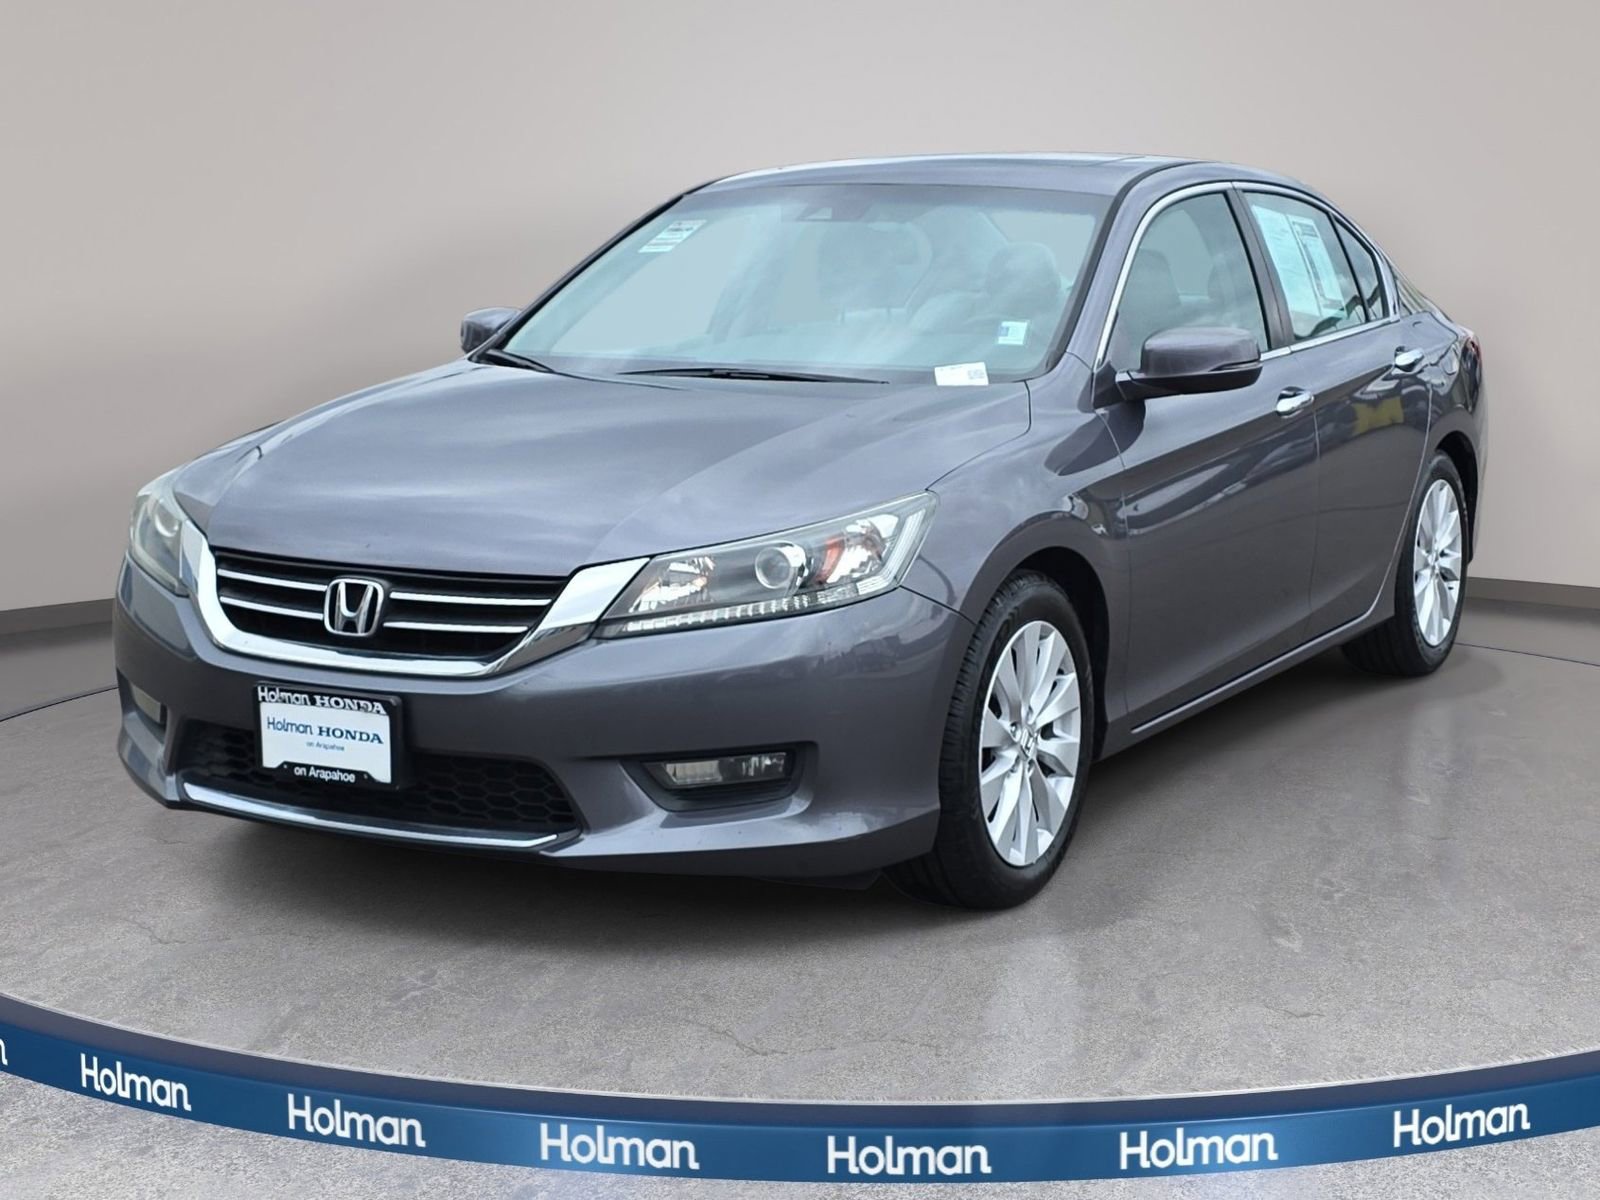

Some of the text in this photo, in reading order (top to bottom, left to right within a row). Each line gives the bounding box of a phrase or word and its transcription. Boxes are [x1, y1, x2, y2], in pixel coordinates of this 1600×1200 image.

[257, 686, 386, 715] Holman HONDA
[267, 716, 384, 744] Holman HONDA
[315, 741, 345, 752] Arapahoe
[293, 766, 356, 783] on Arapahoe
